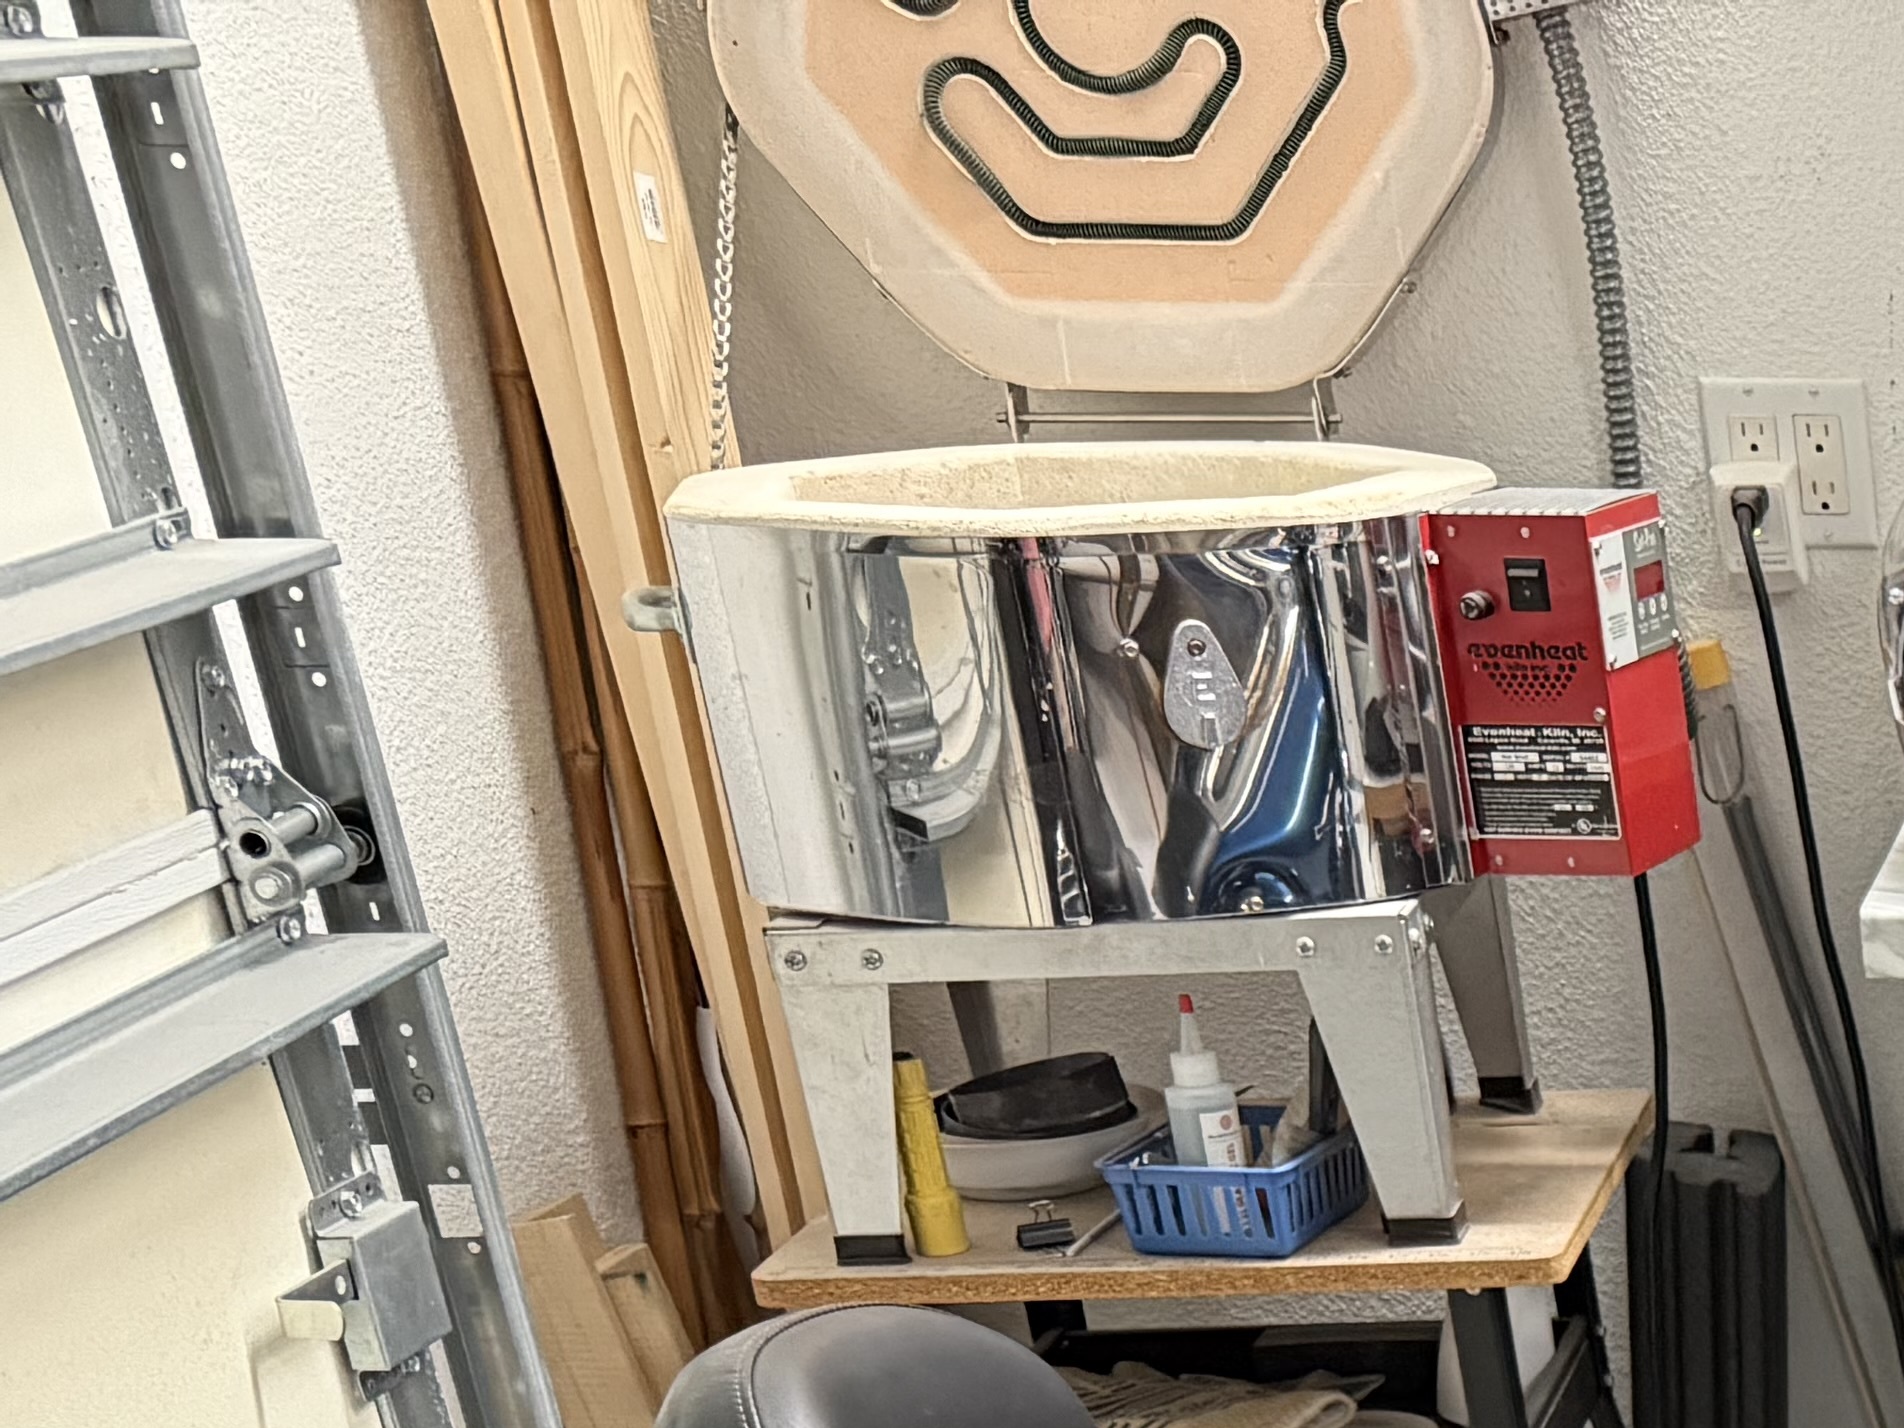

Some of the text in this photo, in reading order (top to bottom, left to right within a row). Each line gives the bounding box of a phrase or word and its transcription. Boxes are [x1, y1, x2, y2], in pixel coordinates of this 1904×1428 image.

[1467, 641, 1588, 661] evenheat
[1472, 726, 1536, 737] Evenheat
[1576, 728, 1602, 738] Inc.
